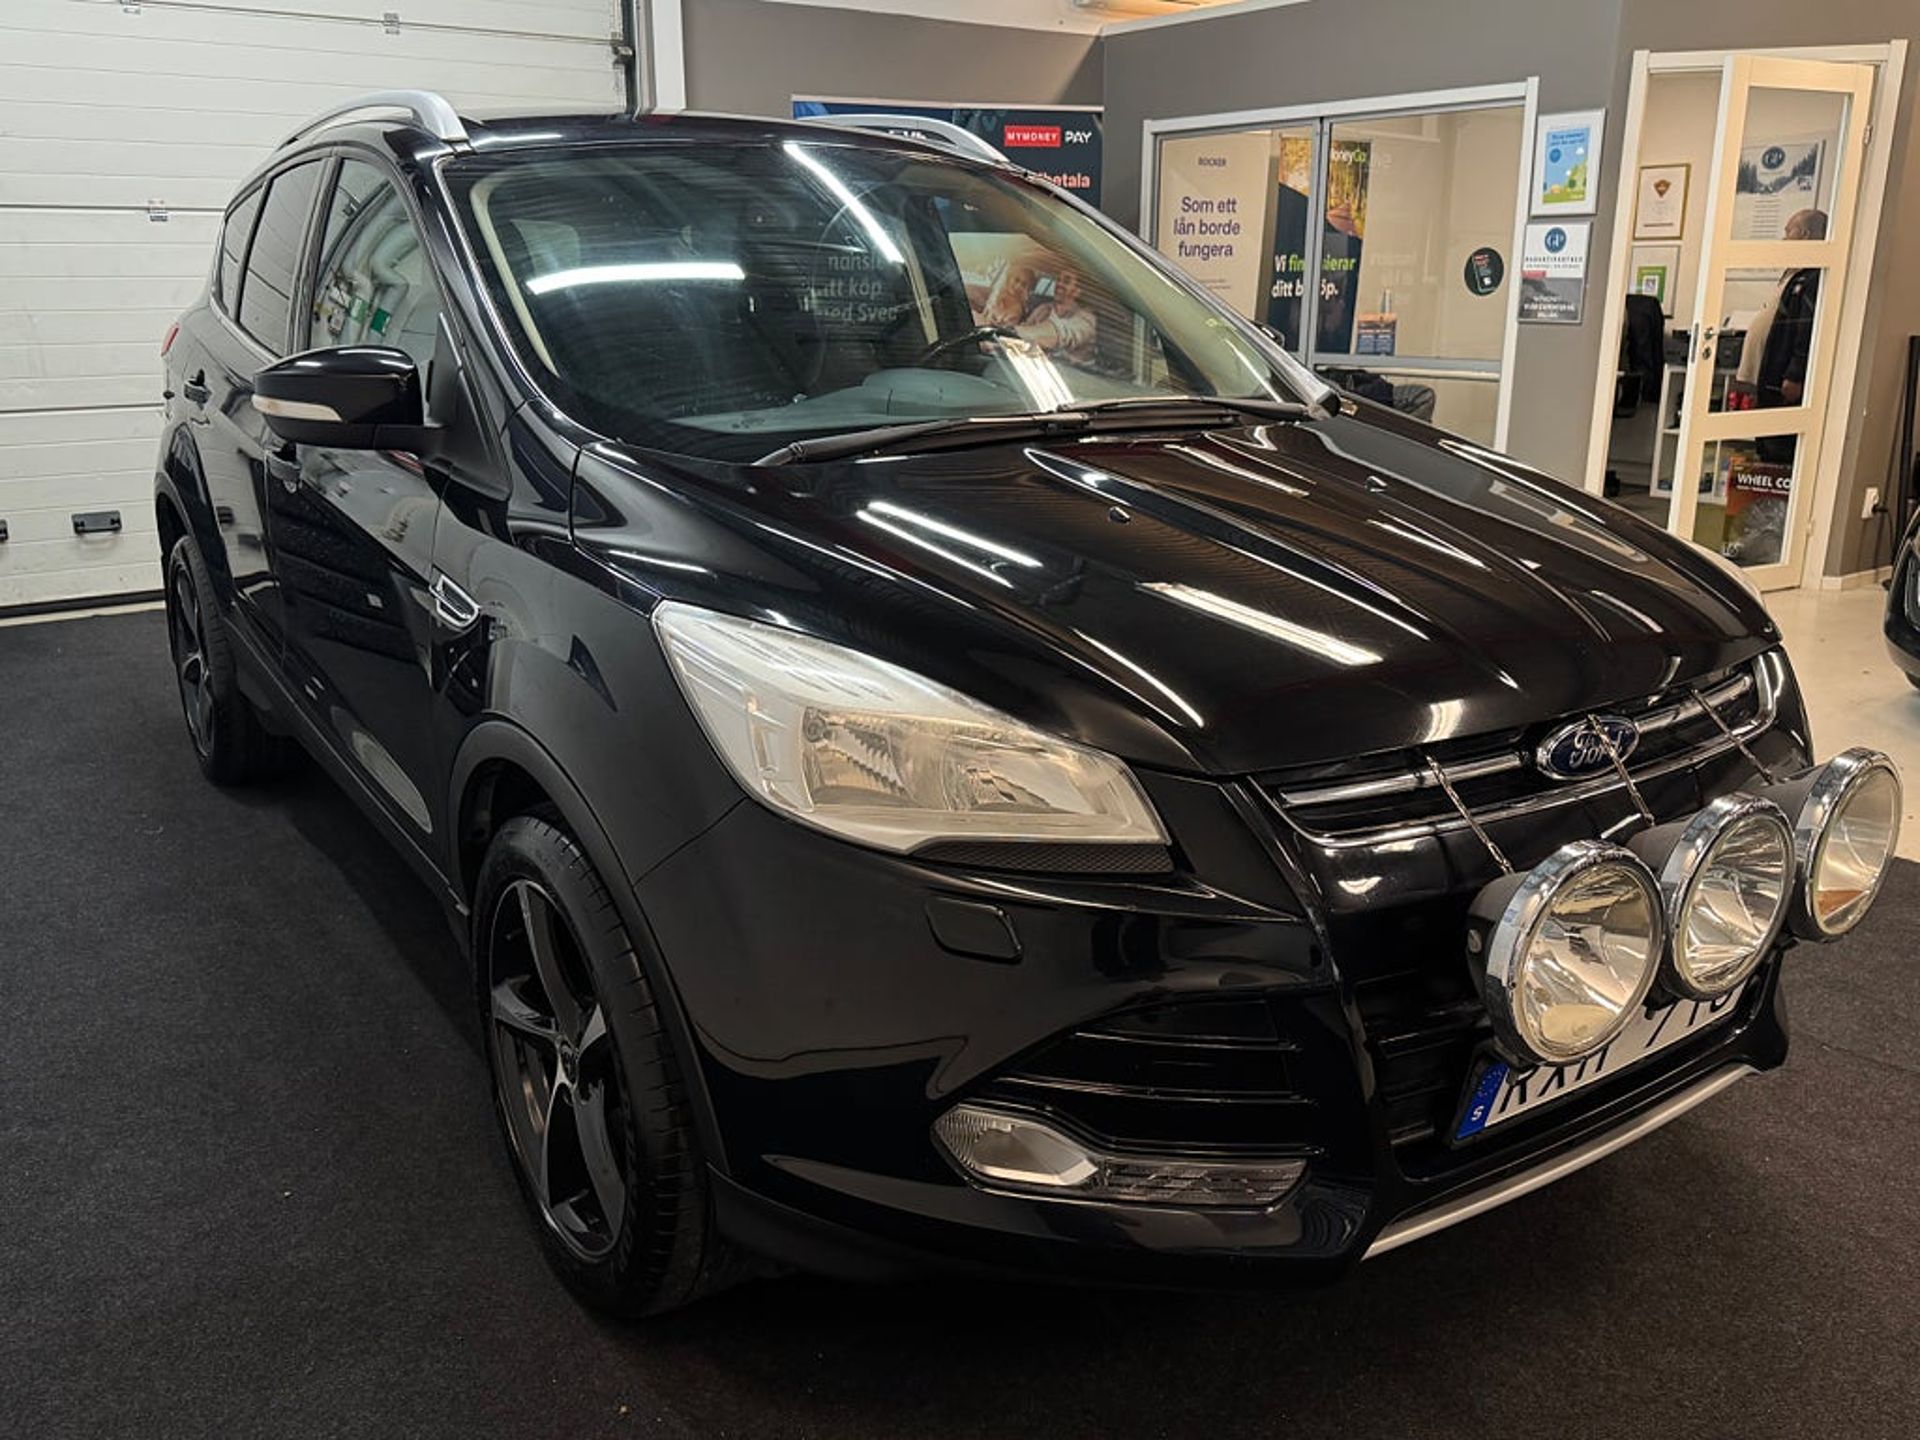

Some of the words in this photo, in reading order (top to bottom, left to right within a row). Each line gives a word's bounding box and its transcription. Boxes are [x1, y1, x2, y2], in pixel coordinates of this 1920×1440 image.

[1007, 131, 1057, 140] MYMONEY
[1064, 130, 1092, 143] PAY
[1181, 196, 1214, 213] Som
[1217, 198, 1237, 213] ett
[1173, 216, 1195, 235] lån
[1199, 218, 1240, 235] borde
[1178, 240, 1233, 260] fungera
[1274, 254, 1287, 272] Vi
[1271, 279, 1293, 298] ditt
[1737, 472, 1773, 487] WHEEL
[1569, 730, 1623, 769] Ford
